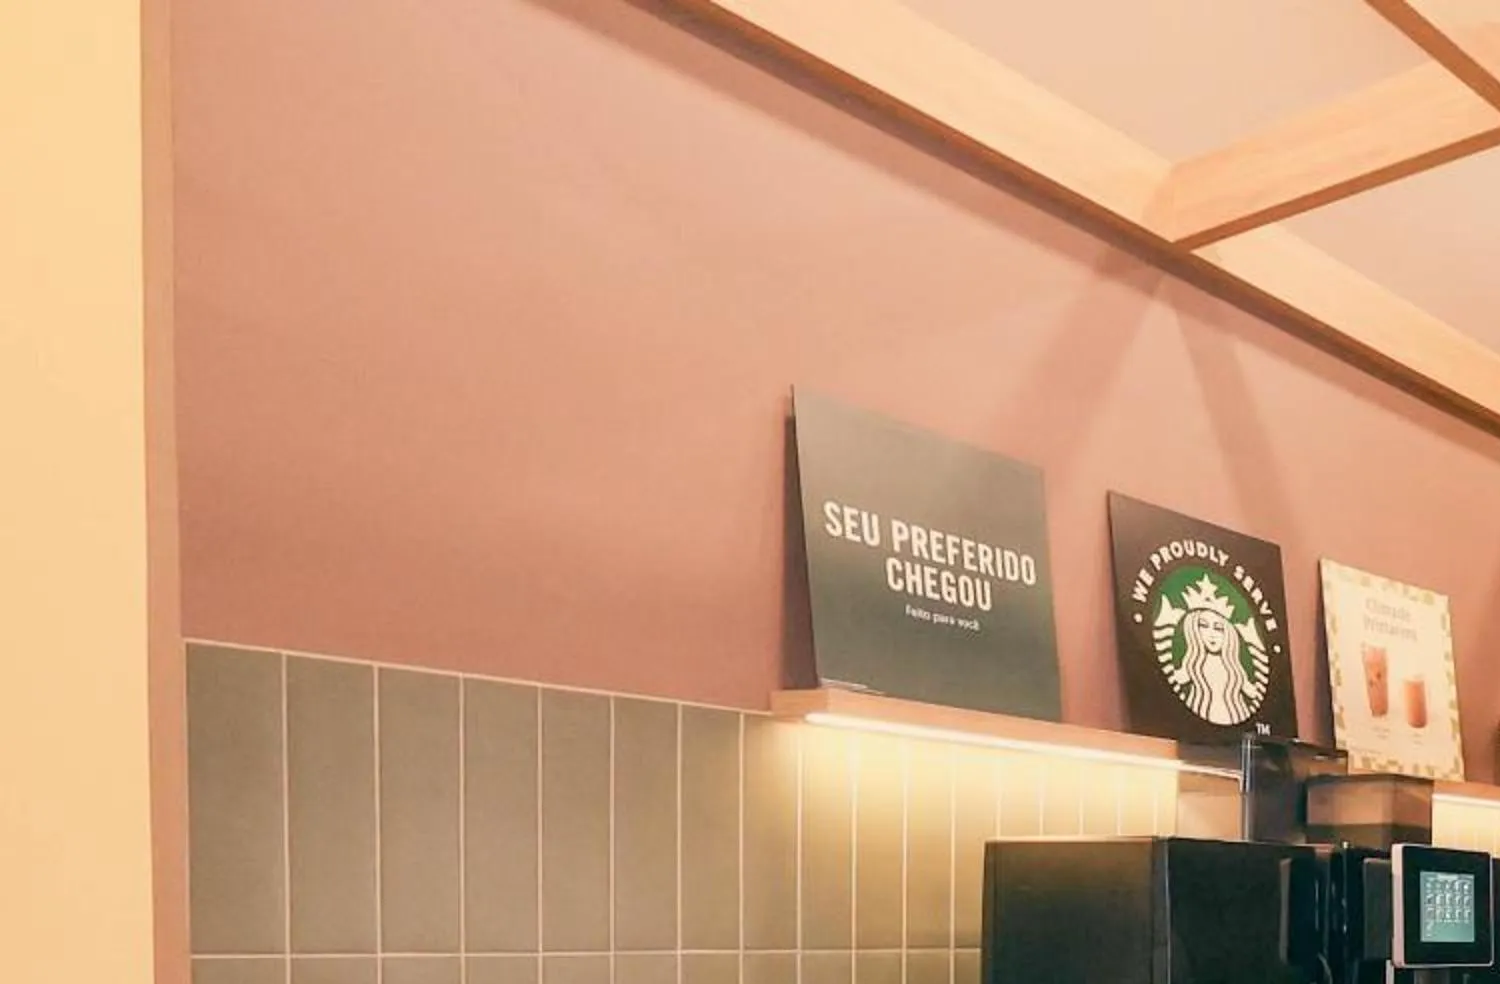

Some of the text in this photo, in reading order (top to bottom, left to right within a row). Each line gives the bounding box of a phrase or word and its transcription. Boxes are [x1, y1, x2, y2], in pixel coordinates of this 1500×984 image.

[823, 500, 1037, 586] SEU PREFERIDO
[886, 556, 993, 612] CHEGOU
[1131, 539, 1279, 632] WE PROUDLY SERVE
